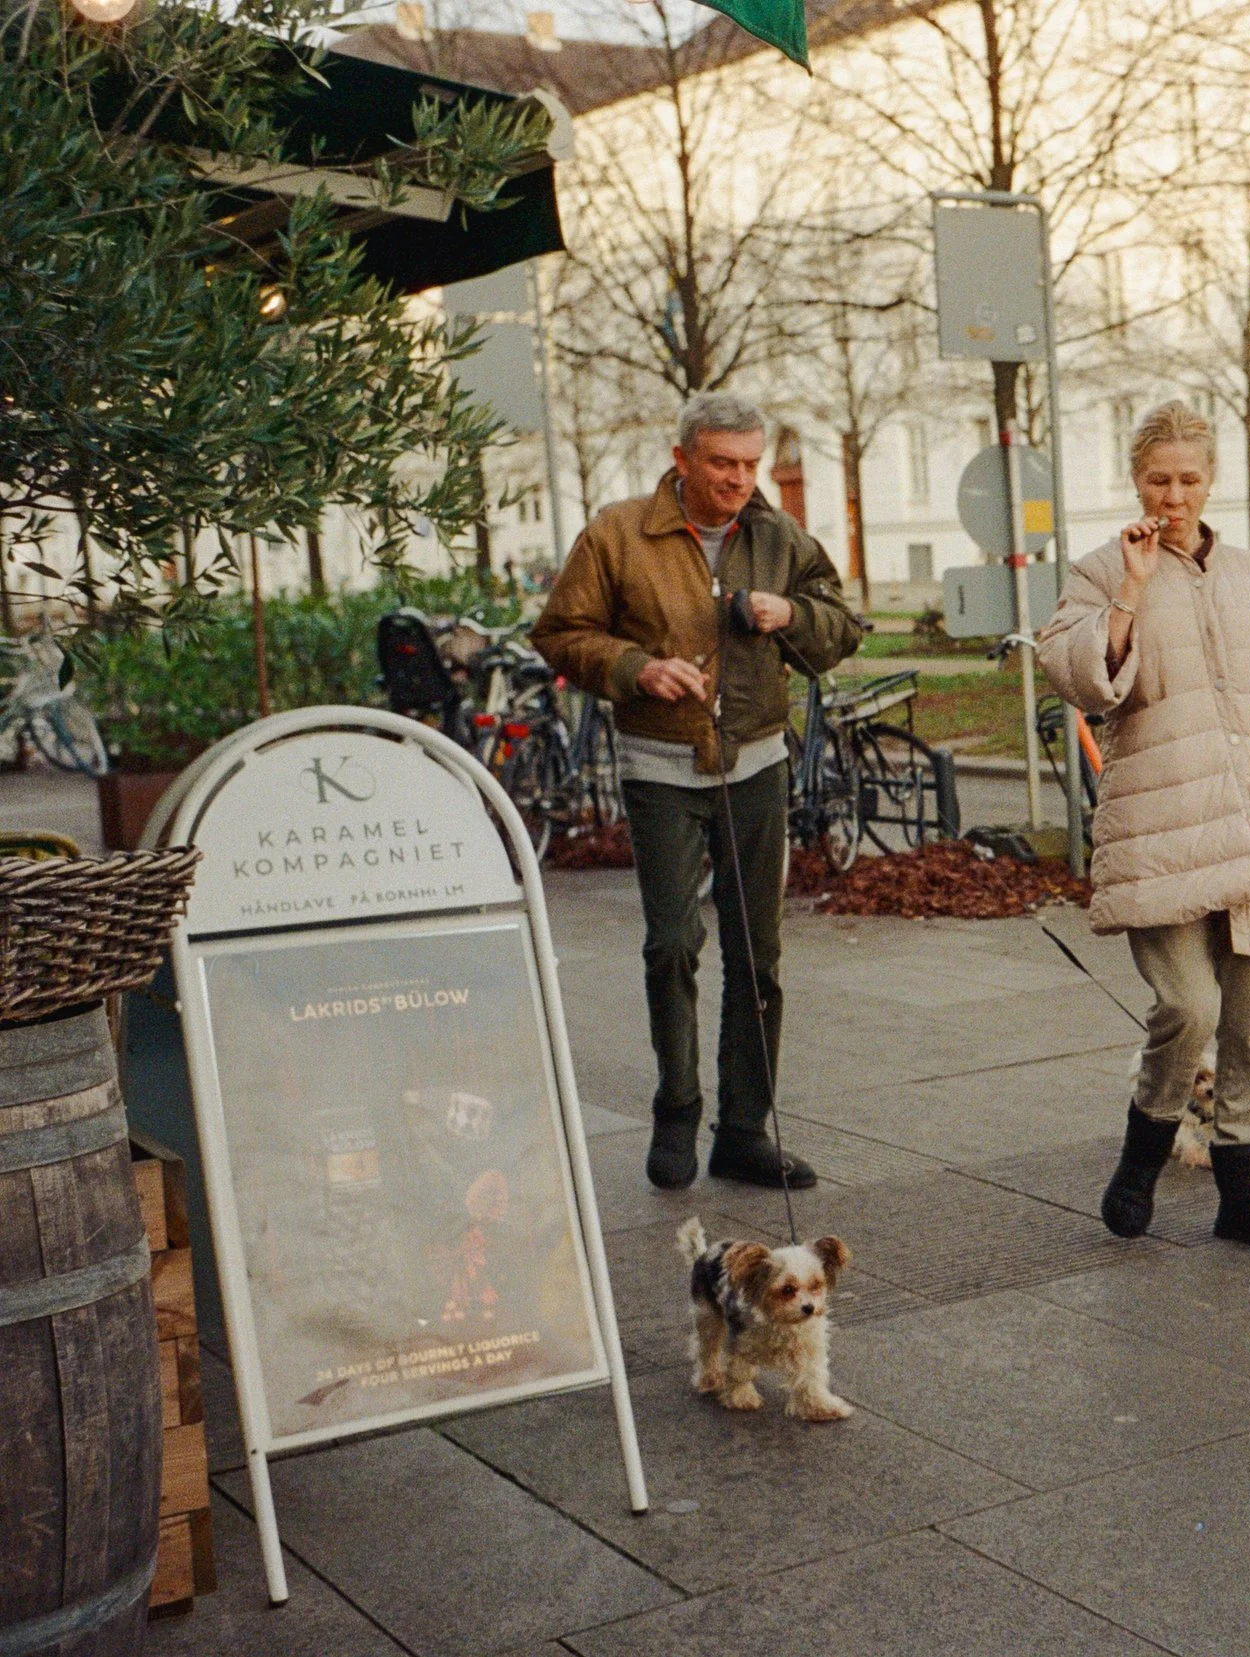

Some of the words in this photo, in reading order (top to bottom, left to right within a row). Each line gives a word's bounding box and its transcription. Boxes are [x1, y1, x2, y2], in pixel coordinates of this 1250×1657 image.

[300, 755, 377, 803] K
[258, 819, 429, 848] KARAMEL
[233, 841, 464, 878] KOMPAGNIET
[376, 884, 464, 902] BORNHLM
[291, 998, 381, 1021] LAKRIDS
[394, 988, 469, 1010] BÜLOW
[486, 1349, 512, 1364] DAY
